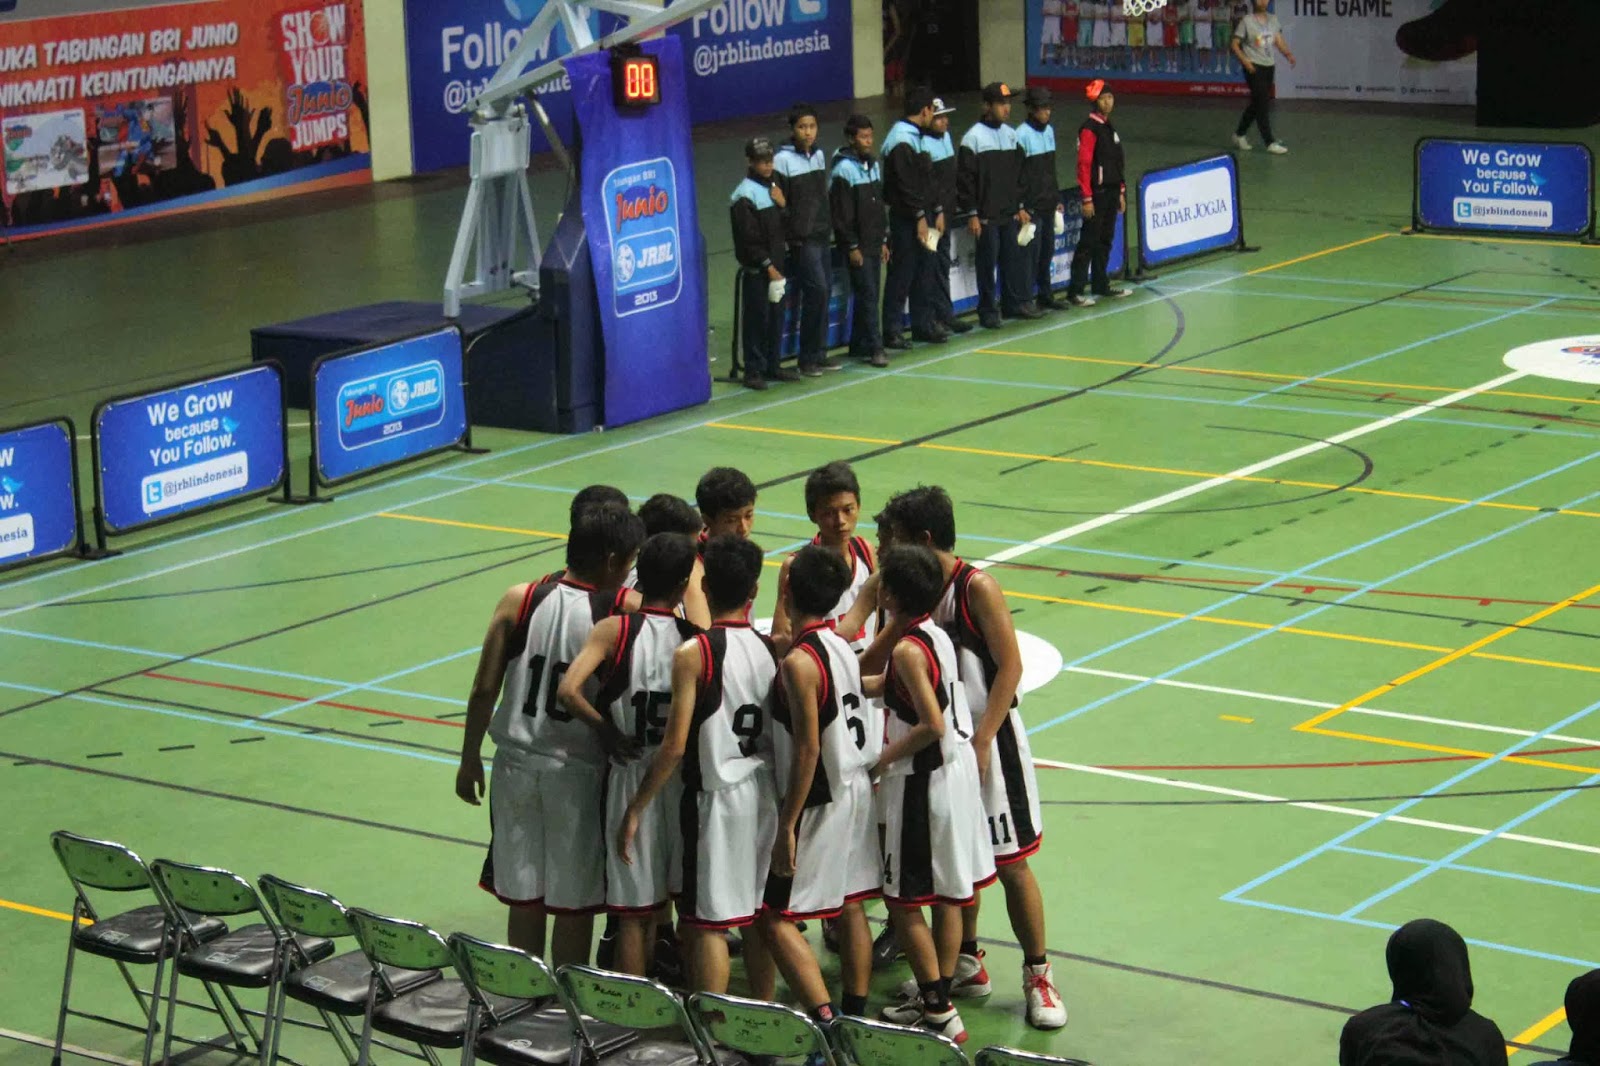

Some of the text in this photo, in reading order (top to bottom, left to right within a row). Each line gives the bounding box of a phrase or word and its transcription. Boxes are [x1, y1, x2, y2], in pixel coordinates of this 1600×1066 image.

[1293, 0, 1393, 18] THE GAME
[43, 32, 145, 66] TABUNGAN
[150, 28, 181, 54] BRI
[185, 21, 238, 50] JUNIO
[442, 21, 550, 73] Follo
[693, 29, 830, 76] @jrblindonesia
[81, 56, 236, 98] KEUNTUNGANNYA
[290, 45, 345, 86] YOUR
[628, 63, 654, 97] 00
[287, 82, 352, 125] Junio
[291, 113, 348, 150] JUMPS
[1462, 148, 1541, 168] We Grow
[1476, 167, 1527, 180] because
[1462, 179, 1543, 196] You Follow.
[615, 183, 668, 235] Junio
[1151, 198, 1228, 230] RADAR JOGJA
[1472, 205, 1548, 218] @jrblindonesia
[636, 241, 674, 269] JRBL
[634, 290, 658, 306] 2013
[410, 378, 438, 399] JRBL
[147, 389, 233, 427] We Grow
[344, 393, 384, 428] Junio
[165, 417, 219, 443] because
[149, 433, 237, 467] You Follow.
[163, 464, 243, 497] @jrblindonesia
[732, 703, 763, 757] 9
[842, 692, 866, 751] 6
[988, 812, 1012, 846] 11
